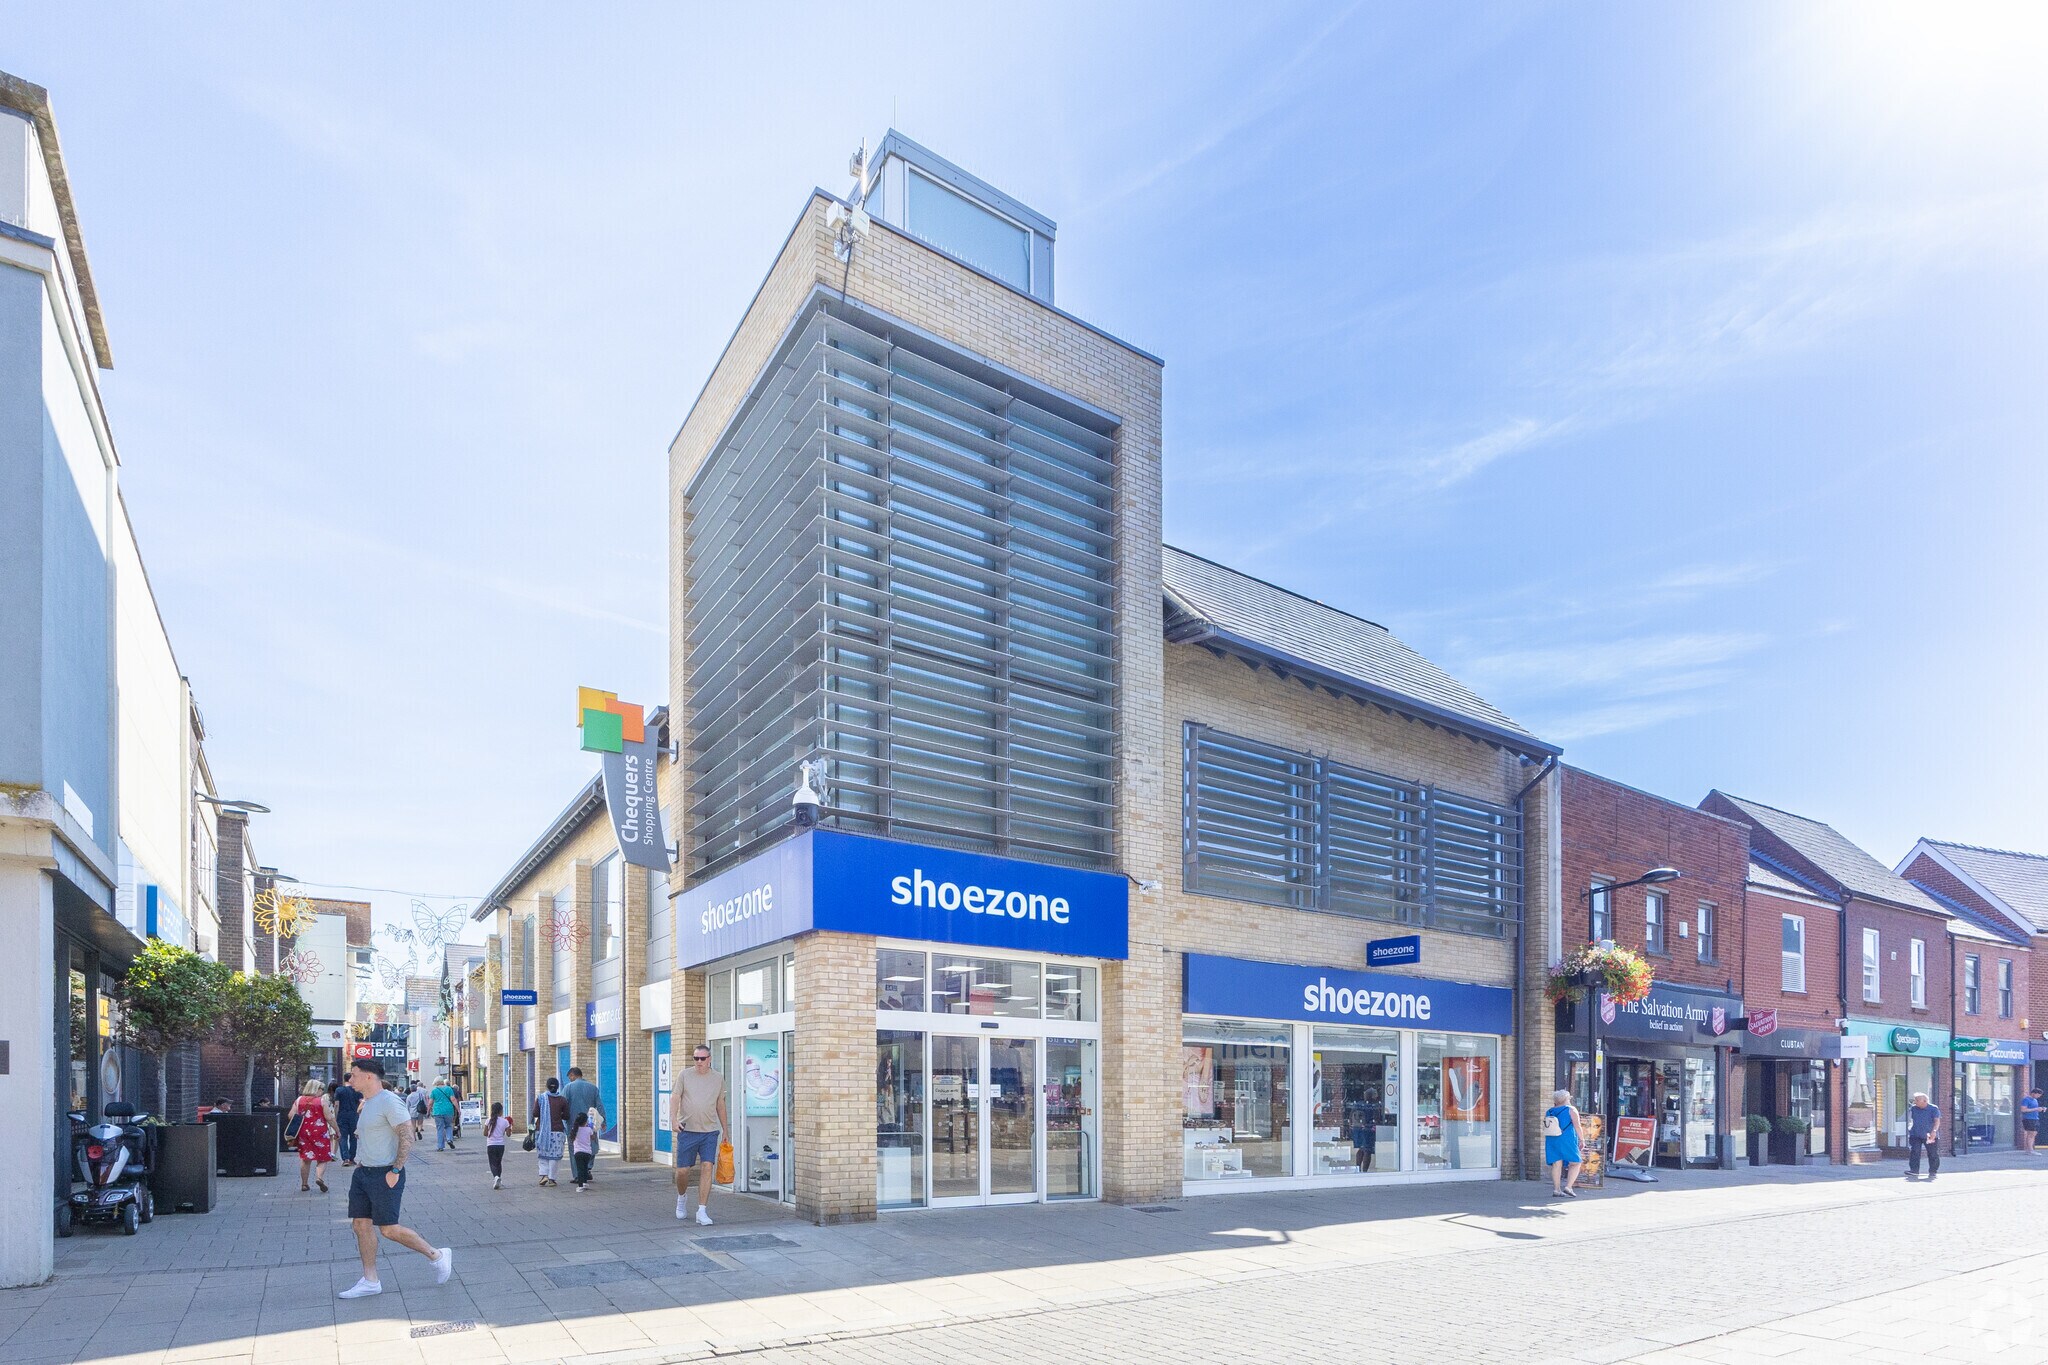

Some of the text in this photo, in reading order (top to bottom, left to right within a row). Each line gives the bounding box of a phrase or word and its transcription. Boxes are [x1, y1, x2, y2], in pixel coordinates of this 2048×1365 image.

[621, 754, 643, 843] Chequers
[643, 758, 656, 846] Shopping Centre
[891, 868, 1070, 924] shoezone
[701, 883, 773, 935] shoezone
[1372, 944, 1415, 957] shoezone
[503, 993, 533, 1001] shoezone
[1303, 976, 1431, 1020] shoezone
[1641, 996, 1683, 1019] Salvation
[1685, 1003, 1709, 1025] Army
[1754, 1012, 1765, 1021] THE
[1649, 1019, 1664, 1031] belief
[1668, 1022, 1684, 1032] action
[1750, 1013, 1775, 1030] SALVATION
[1758, 1022, 1773, 1034] ARMY
[1221, 1034, 1288, 1059] men
[1780, 1038, 1805, 1049] CLUBTAN
[1896, 1033, 1920, 1046] Specsavers
[1989, 1048, 2025, 1060] Accountants
